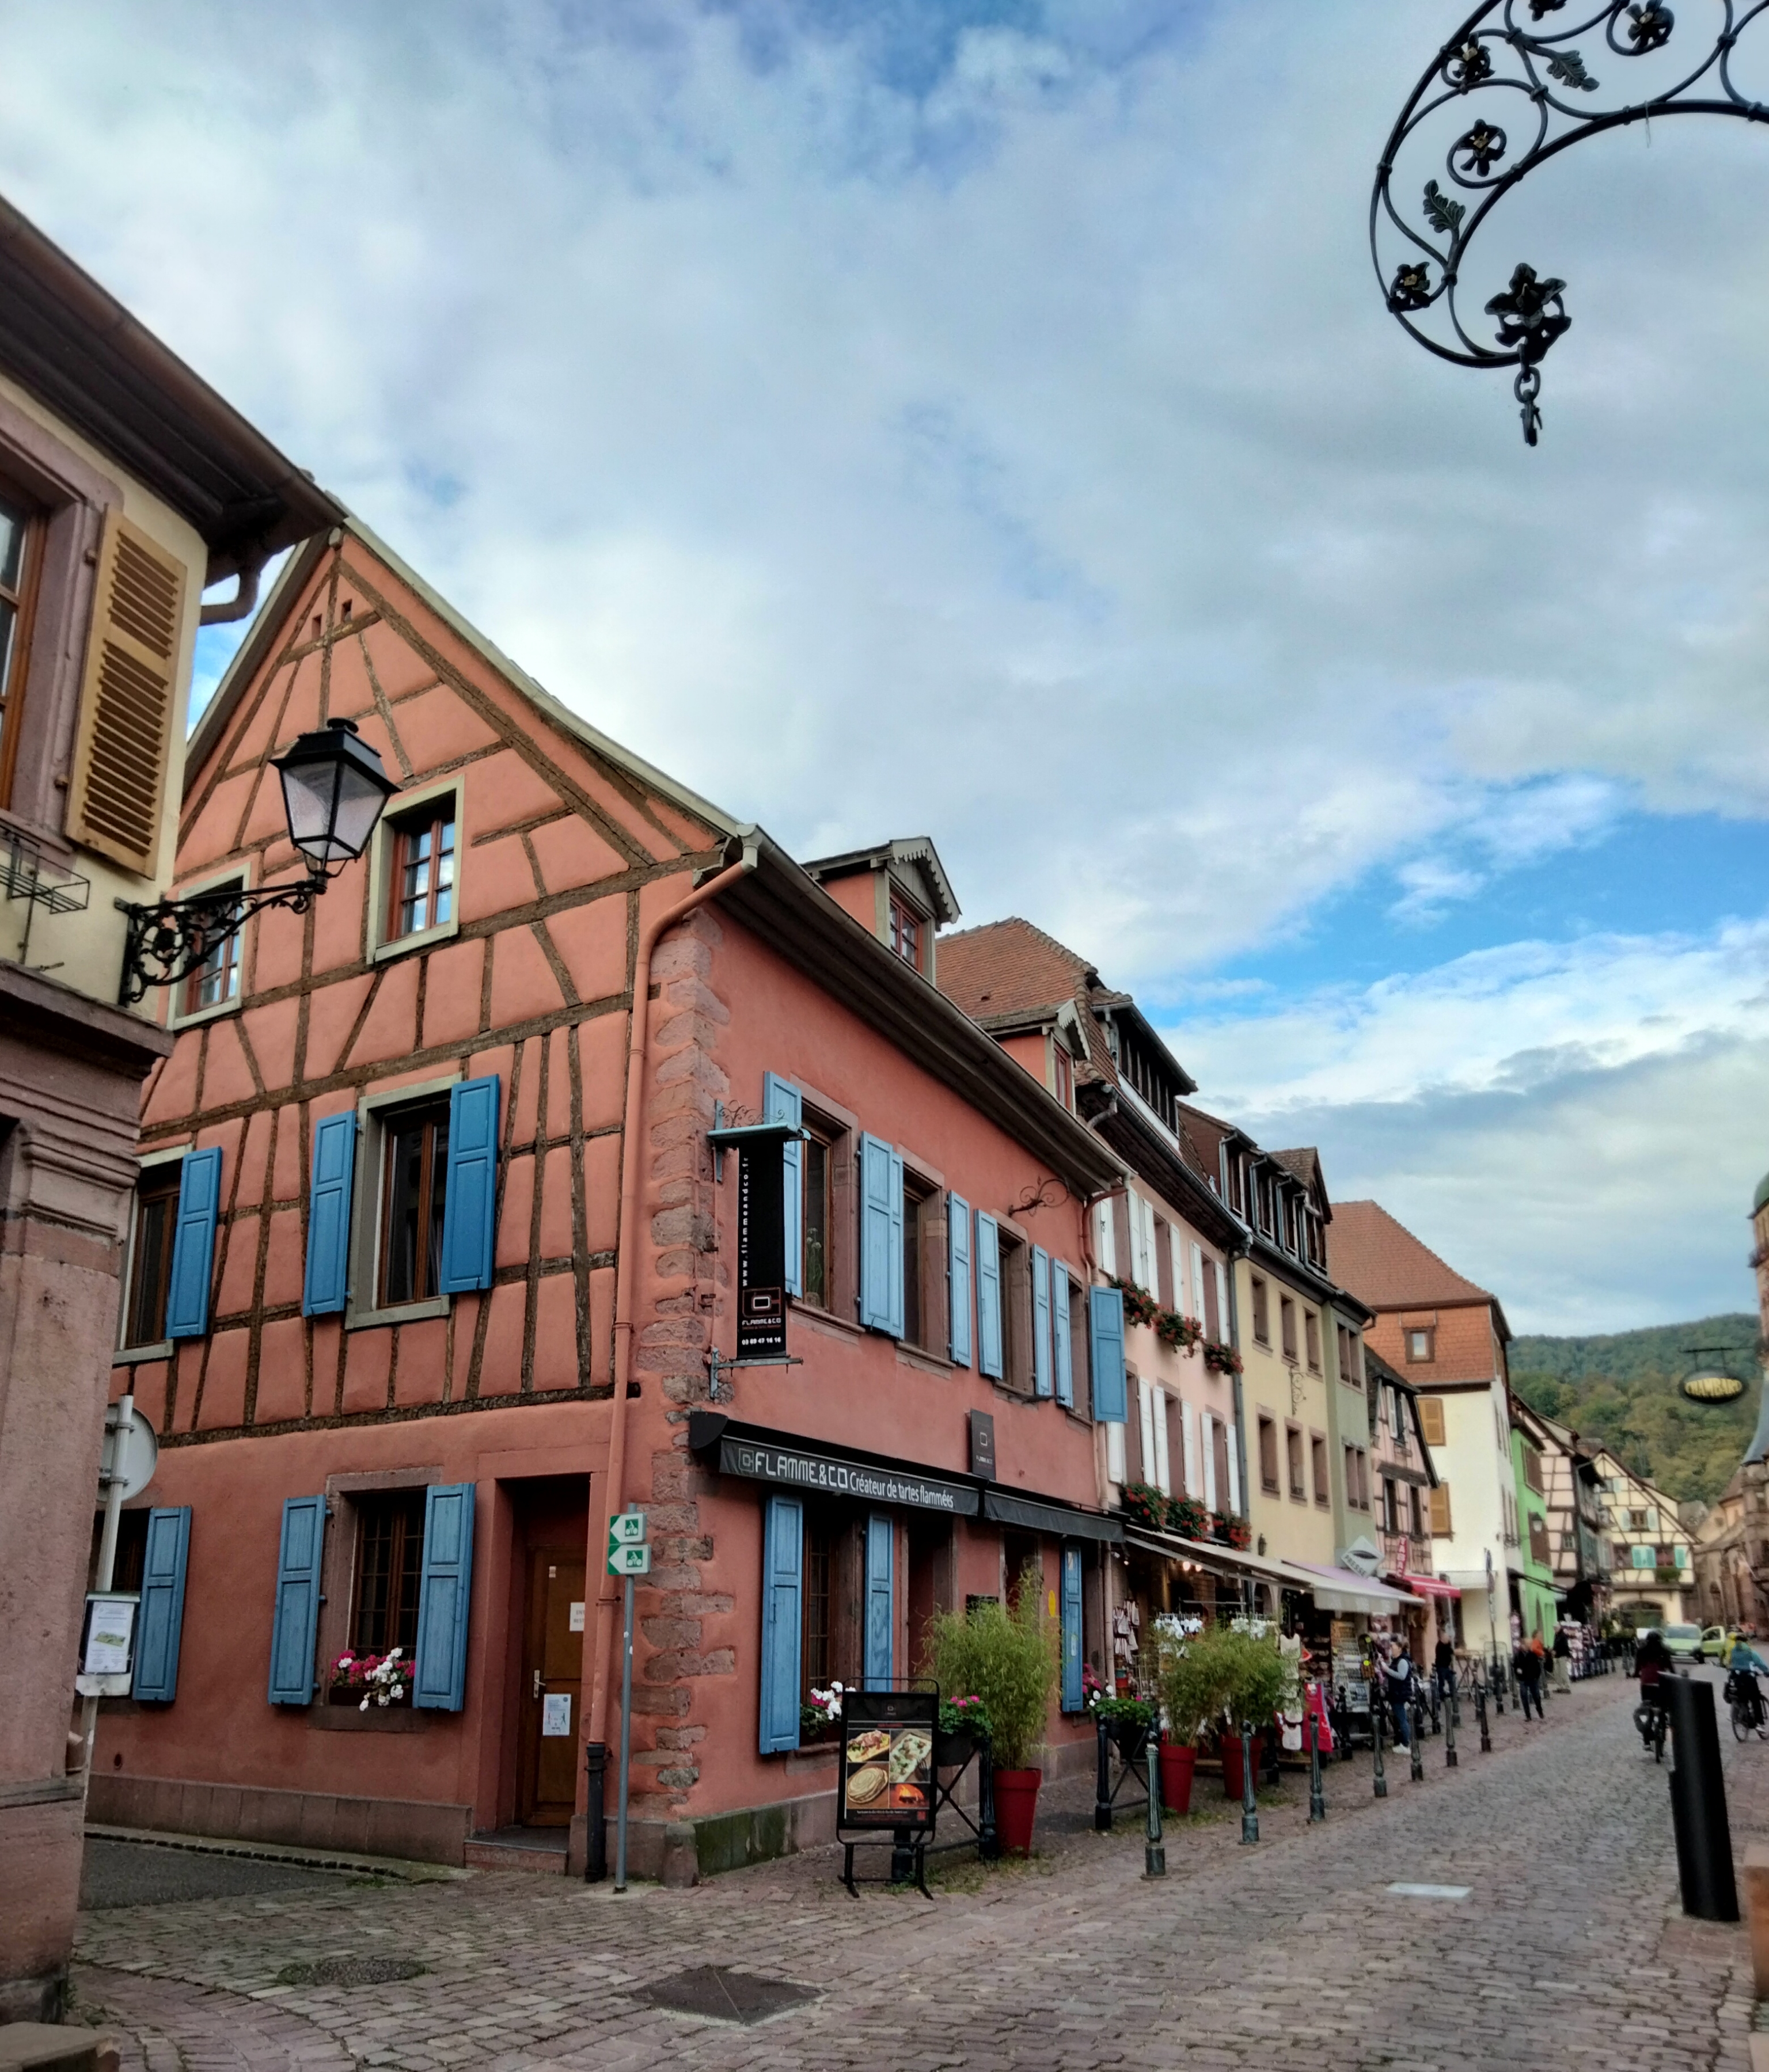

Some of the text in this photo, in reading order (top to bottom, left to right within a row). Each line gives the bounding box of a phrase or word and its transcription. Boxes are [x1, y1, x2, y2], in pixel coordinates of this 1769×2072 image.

[741, 1157, 749, 1287] www.flammeandco.fr
[755, 1451, 954, 1508] FLAMME&CO Créateur de tartes flammées
[1345, 1555, 1367, 1577] PRESSE
[1396, 1535, 1408, 1577] TABAC
